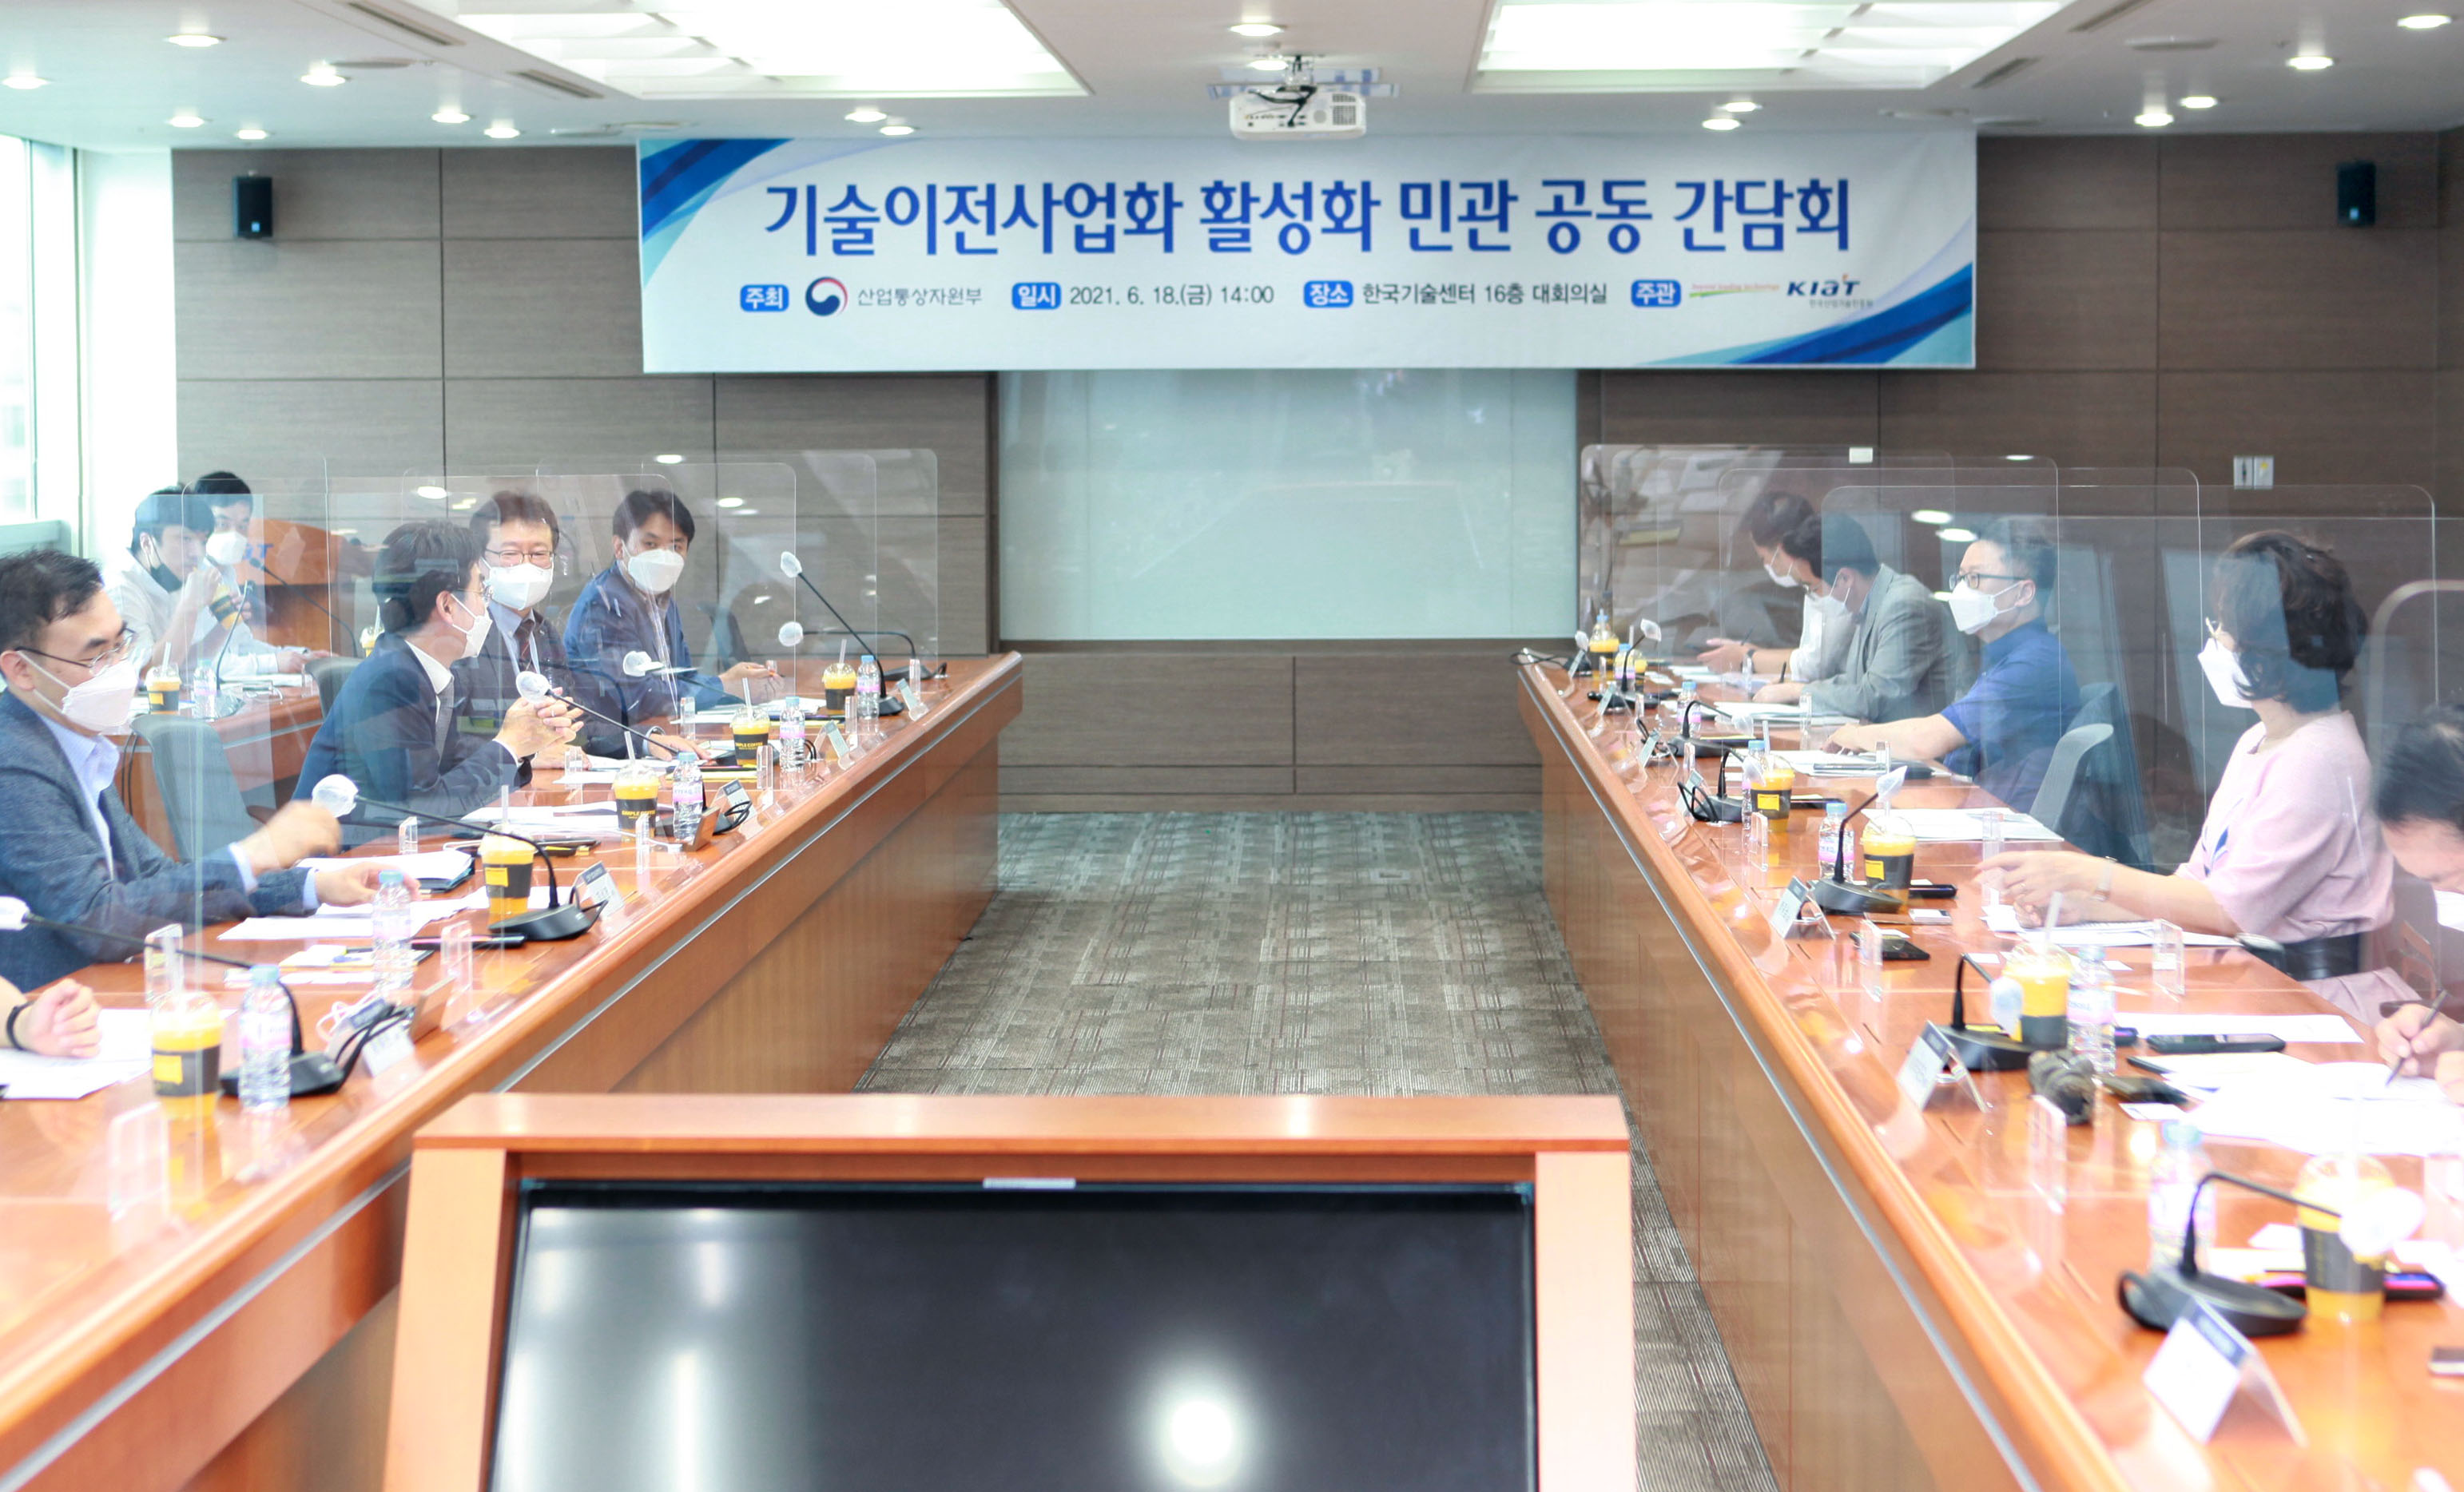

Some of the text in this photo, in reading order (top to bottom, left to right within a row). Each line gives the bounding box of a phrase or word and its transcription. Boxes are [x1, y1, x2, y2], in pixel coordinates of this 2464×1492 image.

[765, 177, 1850, 256] 기술이전사업화 활성화 민관 공동 간담회
[745, 288, 784, 310] 주최
[857, 288, 983, 308] 산업통상자원부
[1018, 286, 1057, 308] 일시
[1070, 286, 1120, 305] 2021.
[1127, 286, 1144, 305] 6.
[1222, 286, 1274, 304] 14:00
[1309, 283, 1608, 306] 장소 한국기술센터 16층 대회의실
[1635, 282, 1676, 305] 주관
